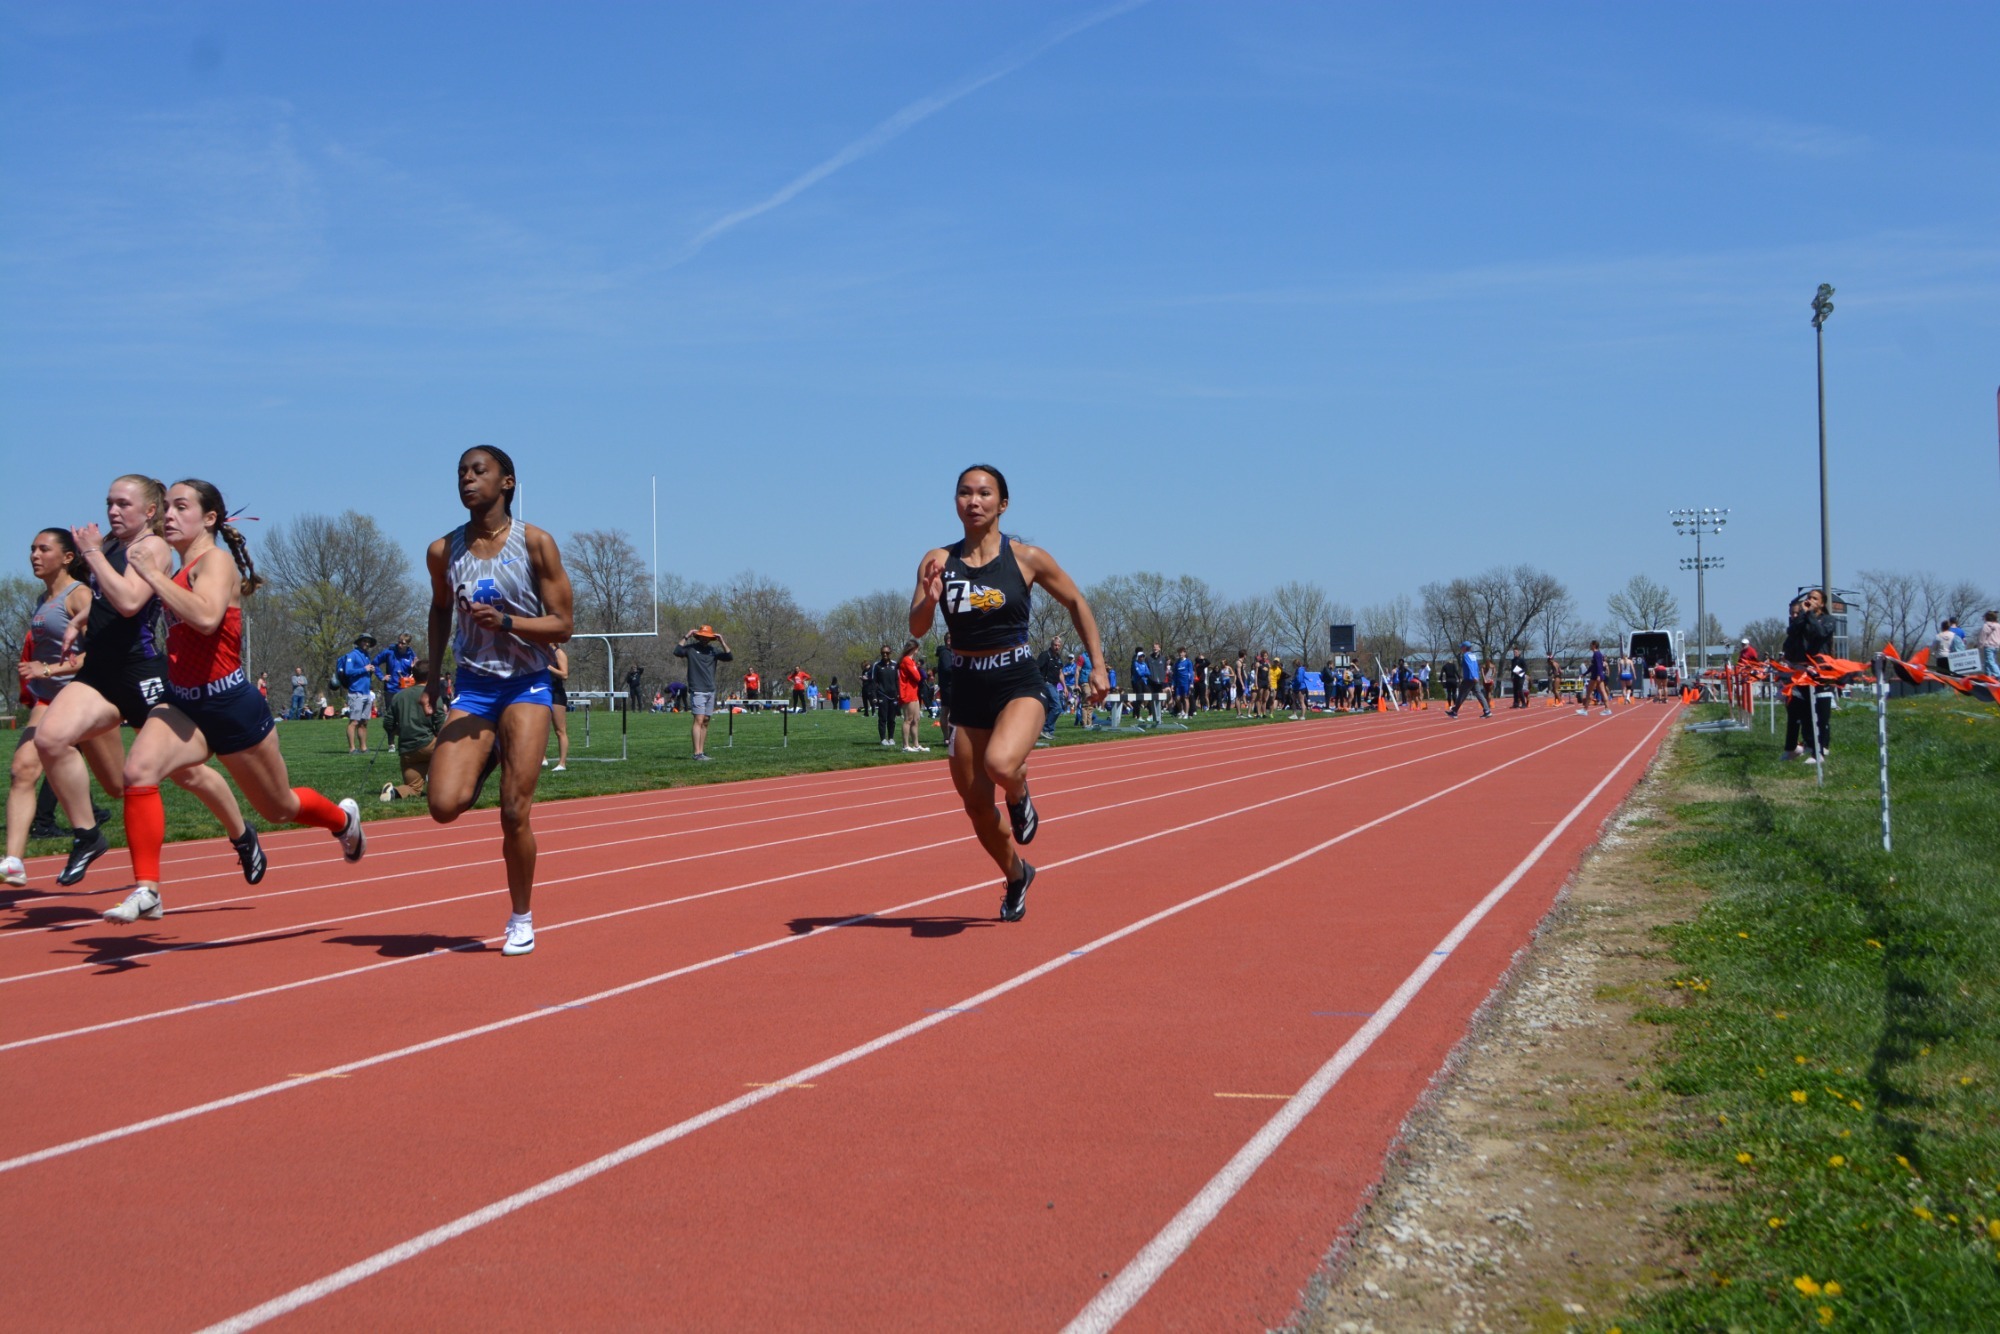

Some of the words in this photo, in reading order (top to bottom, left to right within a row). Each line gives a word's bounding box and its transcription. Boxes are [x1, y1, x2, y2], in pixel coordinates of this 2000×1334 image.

[456, 584, 471, 612] 6
[948, 583, 965, 613] 7
[969, 651, 1011, 671] NIKE
[175, 685, 201, 701] PRO
[207, 668, 244, 697] NIKE
